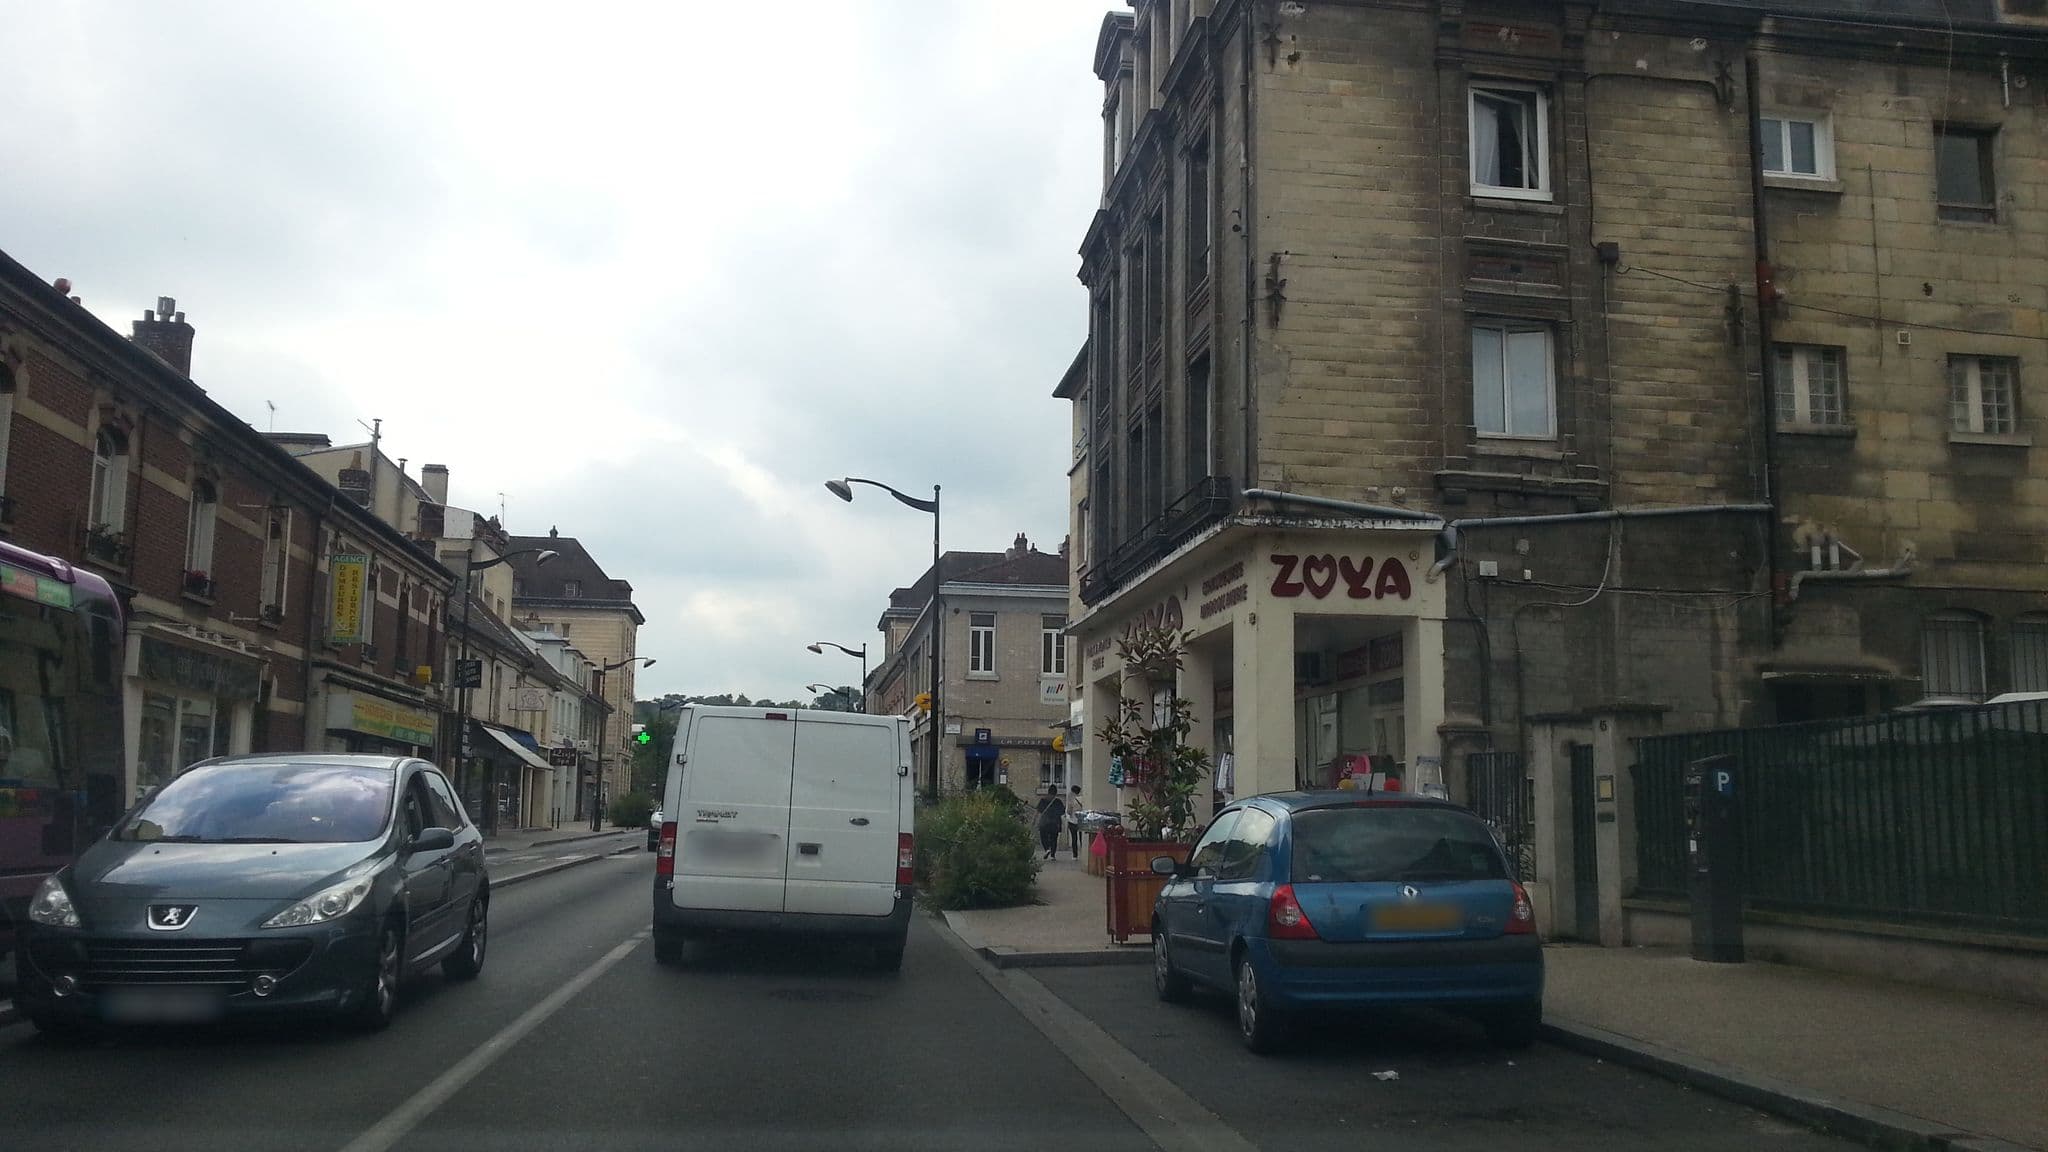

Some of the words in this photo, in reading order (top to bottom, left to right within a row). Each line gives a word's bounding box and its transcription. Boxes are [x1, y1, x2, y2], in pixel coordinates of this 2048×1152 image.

[336, 564, 346, 617] DEMEURES
[1270, 554, 1411, 600] ZOYA
[1717, 771, 1730, 792] P
